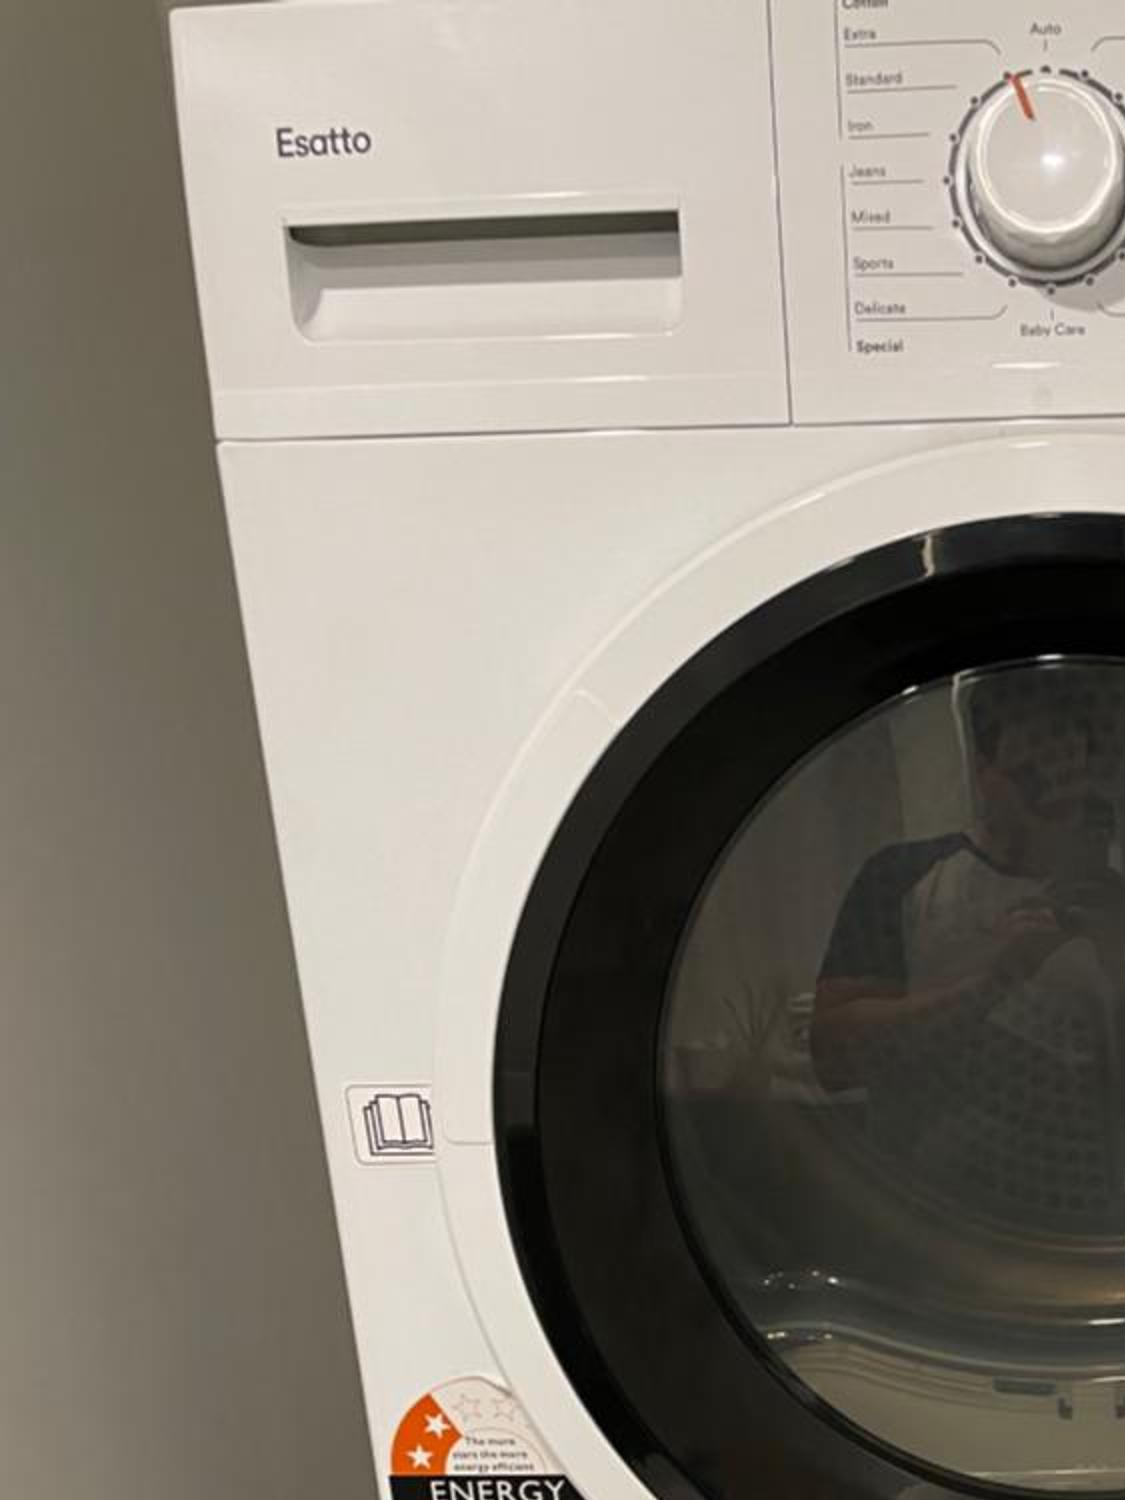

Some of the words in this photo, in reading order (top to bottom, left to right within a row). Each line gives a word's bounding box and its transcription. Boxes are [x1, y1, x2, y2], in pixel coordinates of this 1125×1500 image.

[843, 27, 876, 41] Extra
[1030, 22, 1061, 36] Auto
[846, 71, 902, 87] Standard
[848, 119, 873, 132] Iron
[276, 127, 371, 158] Esatto
[849, 164, 887, 179] Jeans
[851, 211, 890, 225] Mixed
[853, 256, 894, 272] Sports
[854, 301, 906, 315] Delicate
[1020, 323, 1054, 338] Baby
[1058, 323, 1086, 337] Care
[856, 340, 904, 355] Special
